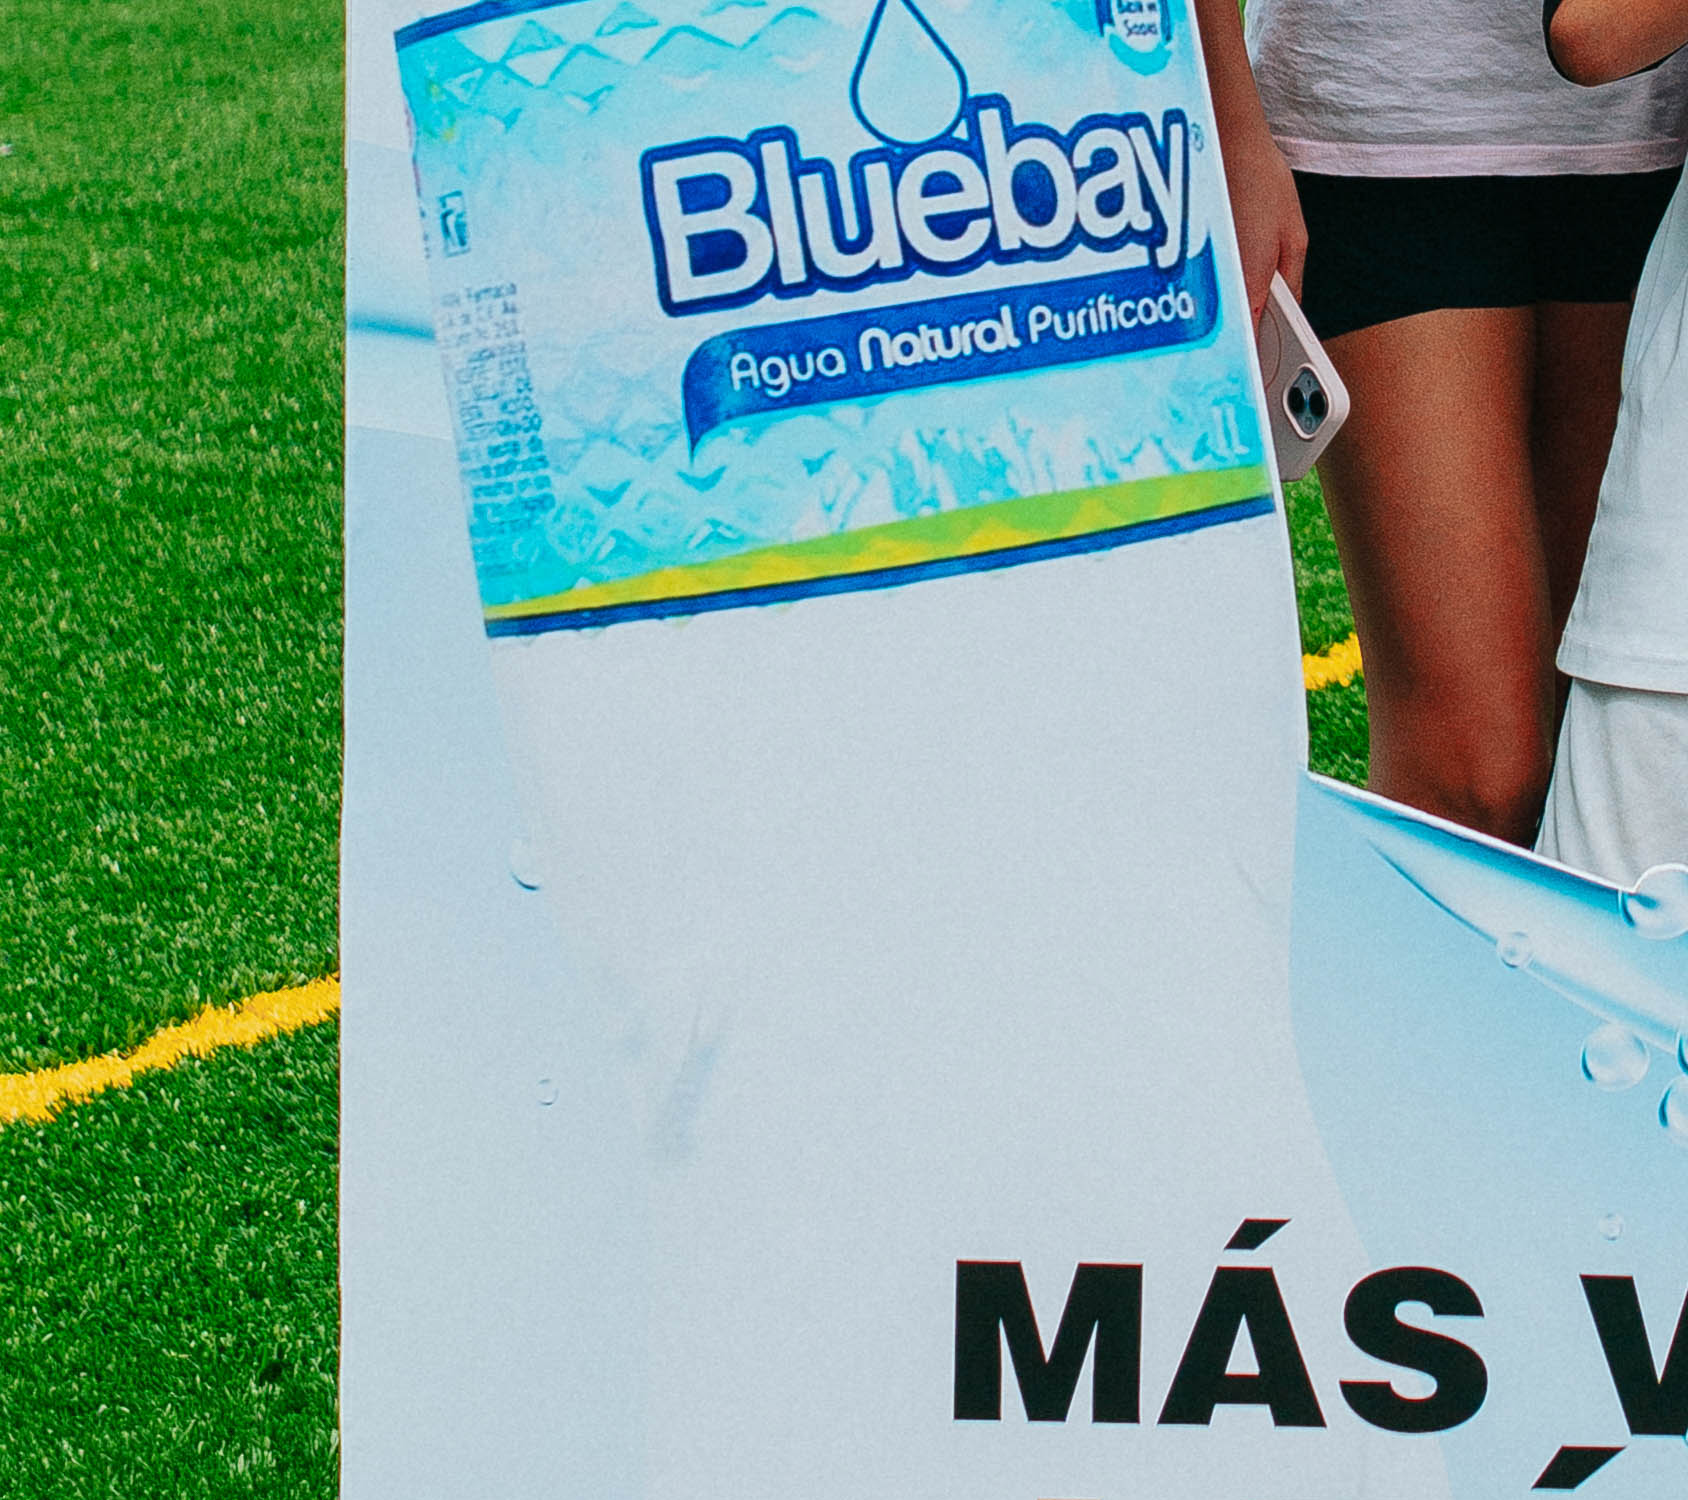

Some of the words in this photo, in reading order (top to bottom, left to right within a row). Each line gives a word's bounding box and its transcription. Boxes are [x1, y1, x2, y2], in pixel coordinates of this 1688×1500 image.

[641, 92, 1191, 316] Bluebay
[729, 347, 847, 398] Agua
[858, 304, 1022, 371] Natural
[1027, 284, 1198, 344] Purificada
[954, 1219, 1489, 1436] MÁS
